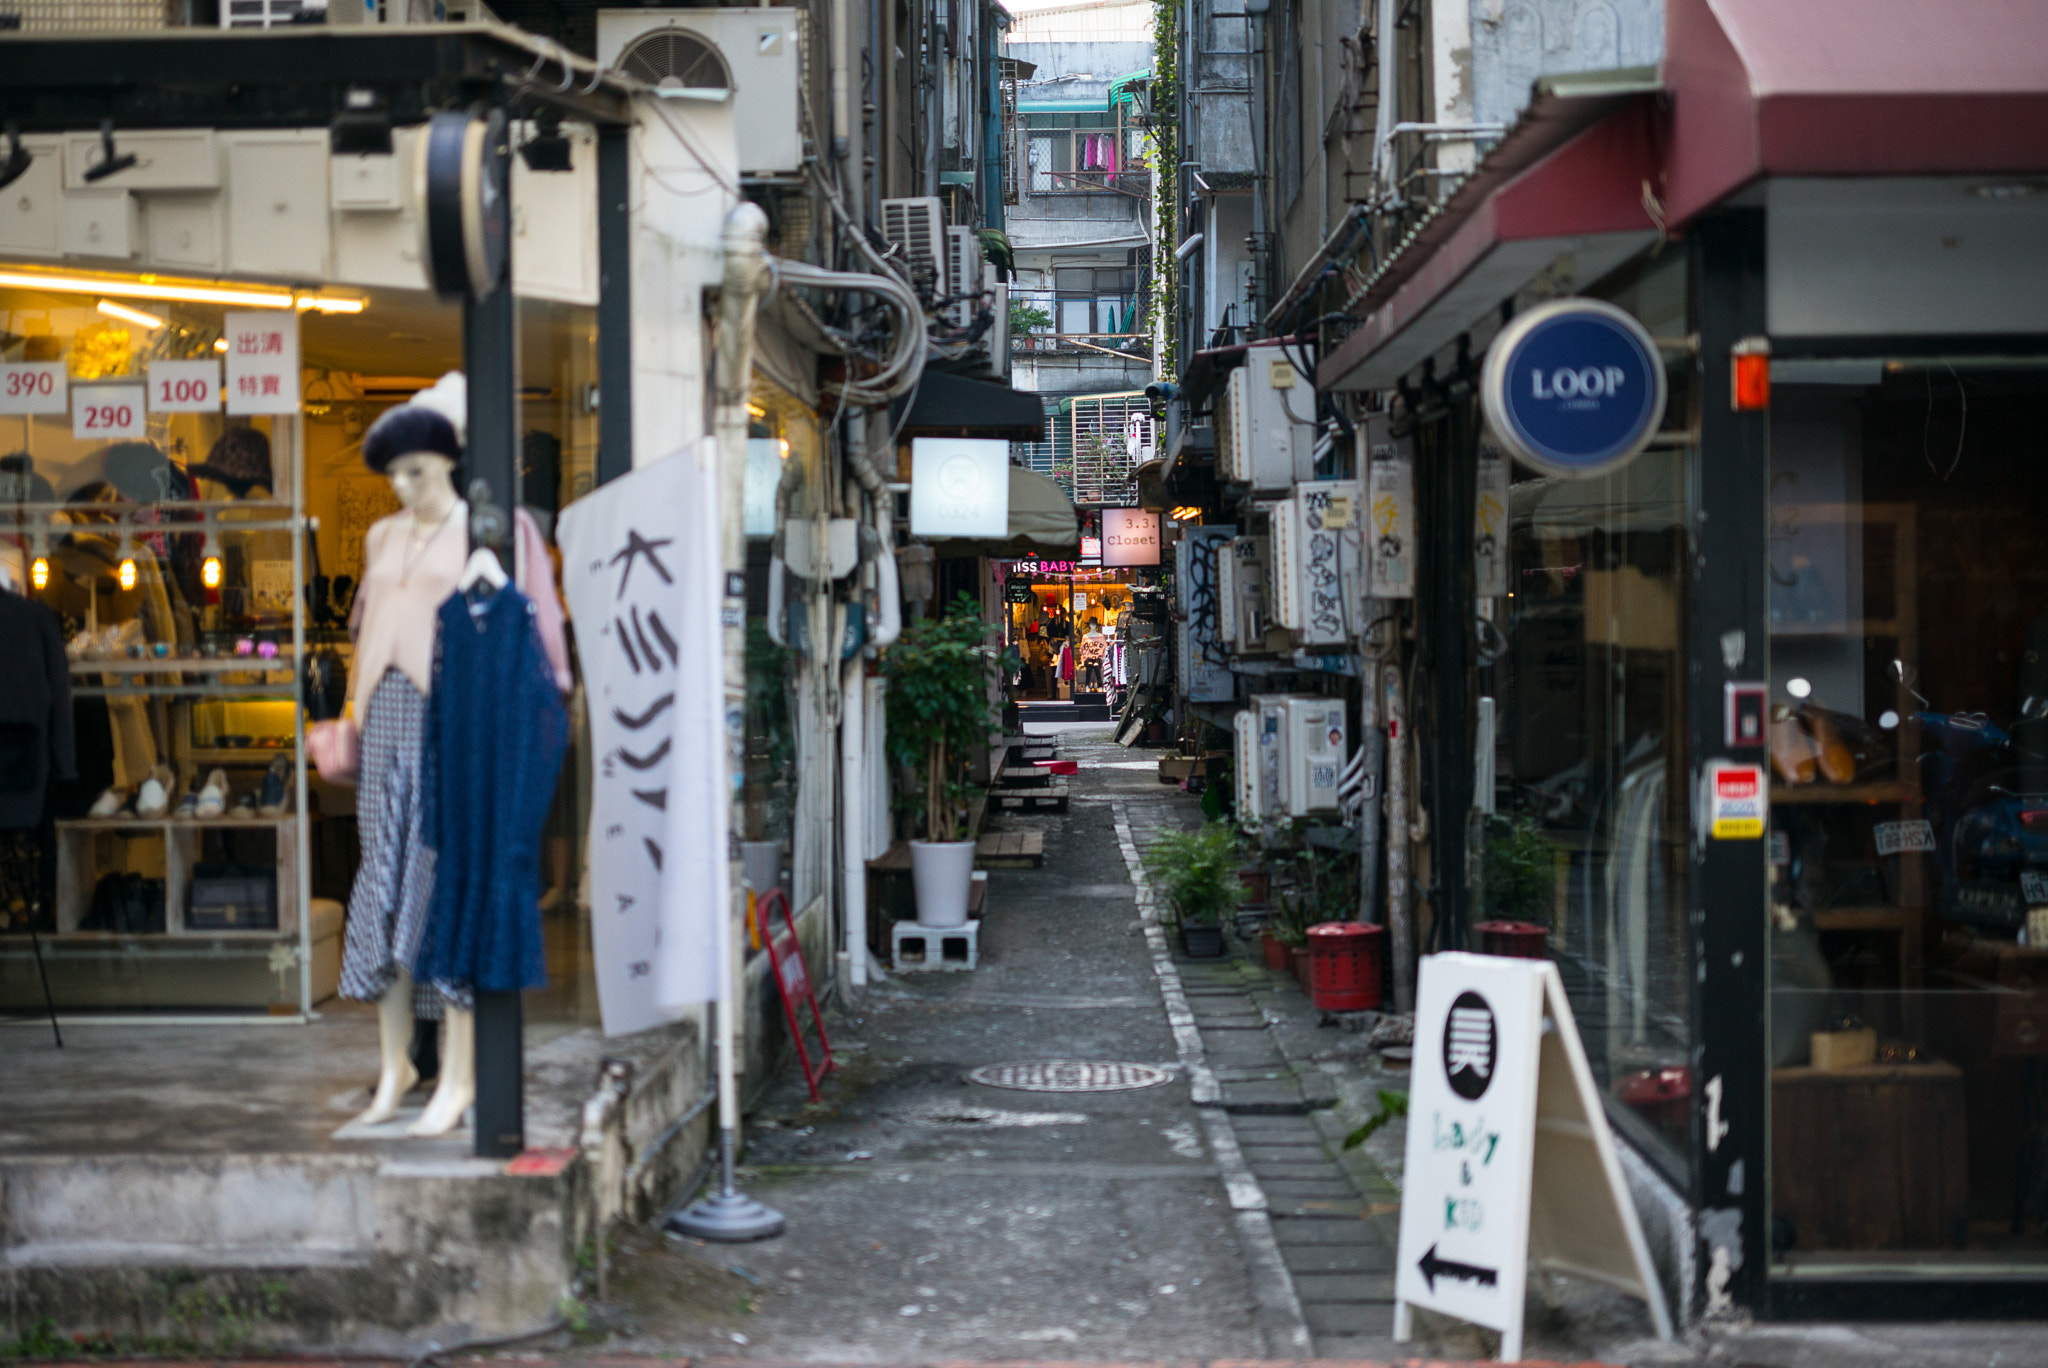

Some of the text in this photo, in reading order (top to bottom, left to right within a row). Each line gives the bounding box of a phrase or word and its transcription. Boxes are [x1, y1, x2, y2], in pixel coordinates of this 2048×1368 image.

[237, 331, 283, 355] 出清
[6, 371, 54, 396] 390
[161, 379, 208, 402] 100
[237, 374, 281, 397] 特賣
[1531, 366, 1626, 400] LOOP
[84, 405, 132, 428] 290
[1126, 518, 1156, 529] 3.3.
[1107, 535, 1156, 546] Closet
[1040, 561, 1076, 572] BABY
